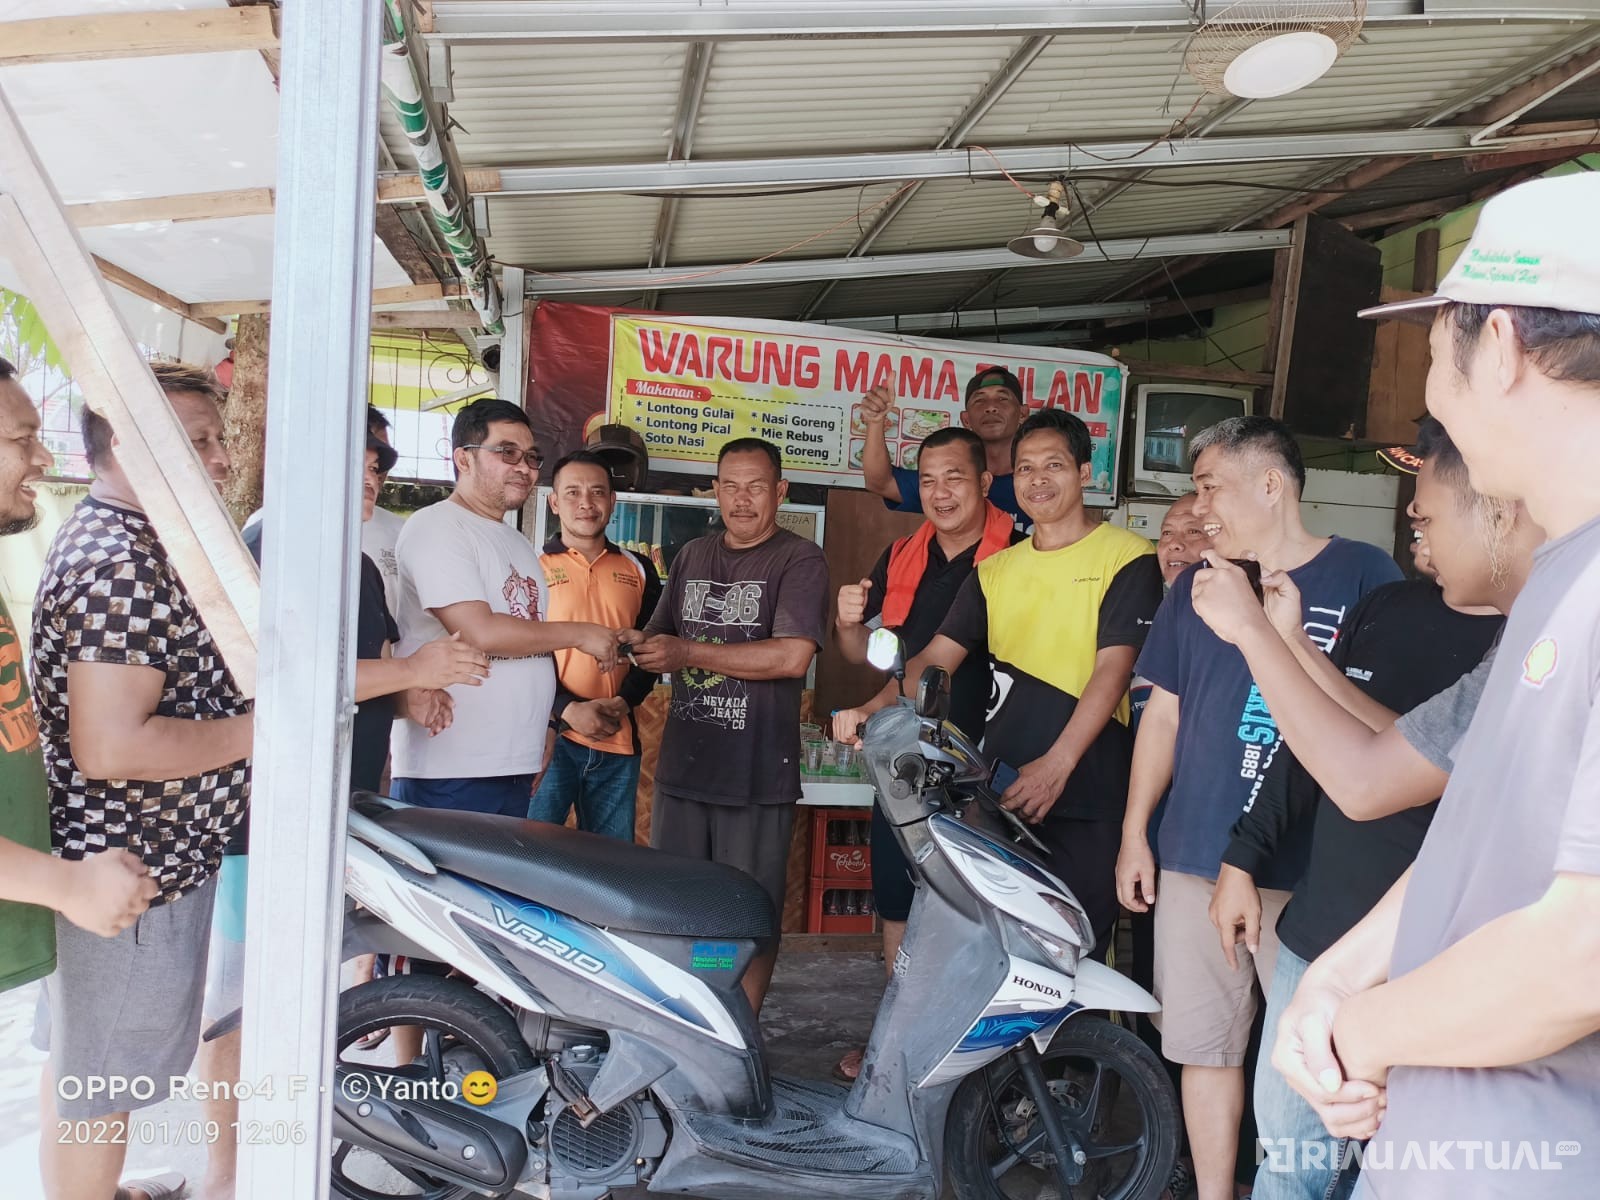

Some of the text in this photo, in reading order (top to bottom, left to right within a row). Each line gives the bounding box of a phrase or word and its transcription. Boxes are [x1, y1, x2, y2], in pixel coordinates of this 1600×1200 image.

[638, 328, 821, 389] WARUNG
[834, 349, 959, 402] MAMA
[635, 382, 695, 399] Makanan
[647, 401, 735, 420] Lontong Gulai
[646, 417, 731, 435] Lontong Pical
[762, 413, 836, 431] Nasi Goreng
[645, 432, 705, 447] Soto Nasi
[761, 427, 824, 443] Mie Rebus
[785, 444, 829, 460] Goreng
[703, 695, 747, 708] NEVADA
[711, 707, 747, 718] JEANS
[732, 719, 745, 730] CO
[1240, 743, 1262, 779] 1889
[492, 903, 606, 975] VARIO
[1012, 975, 1062, 999] HONDA
